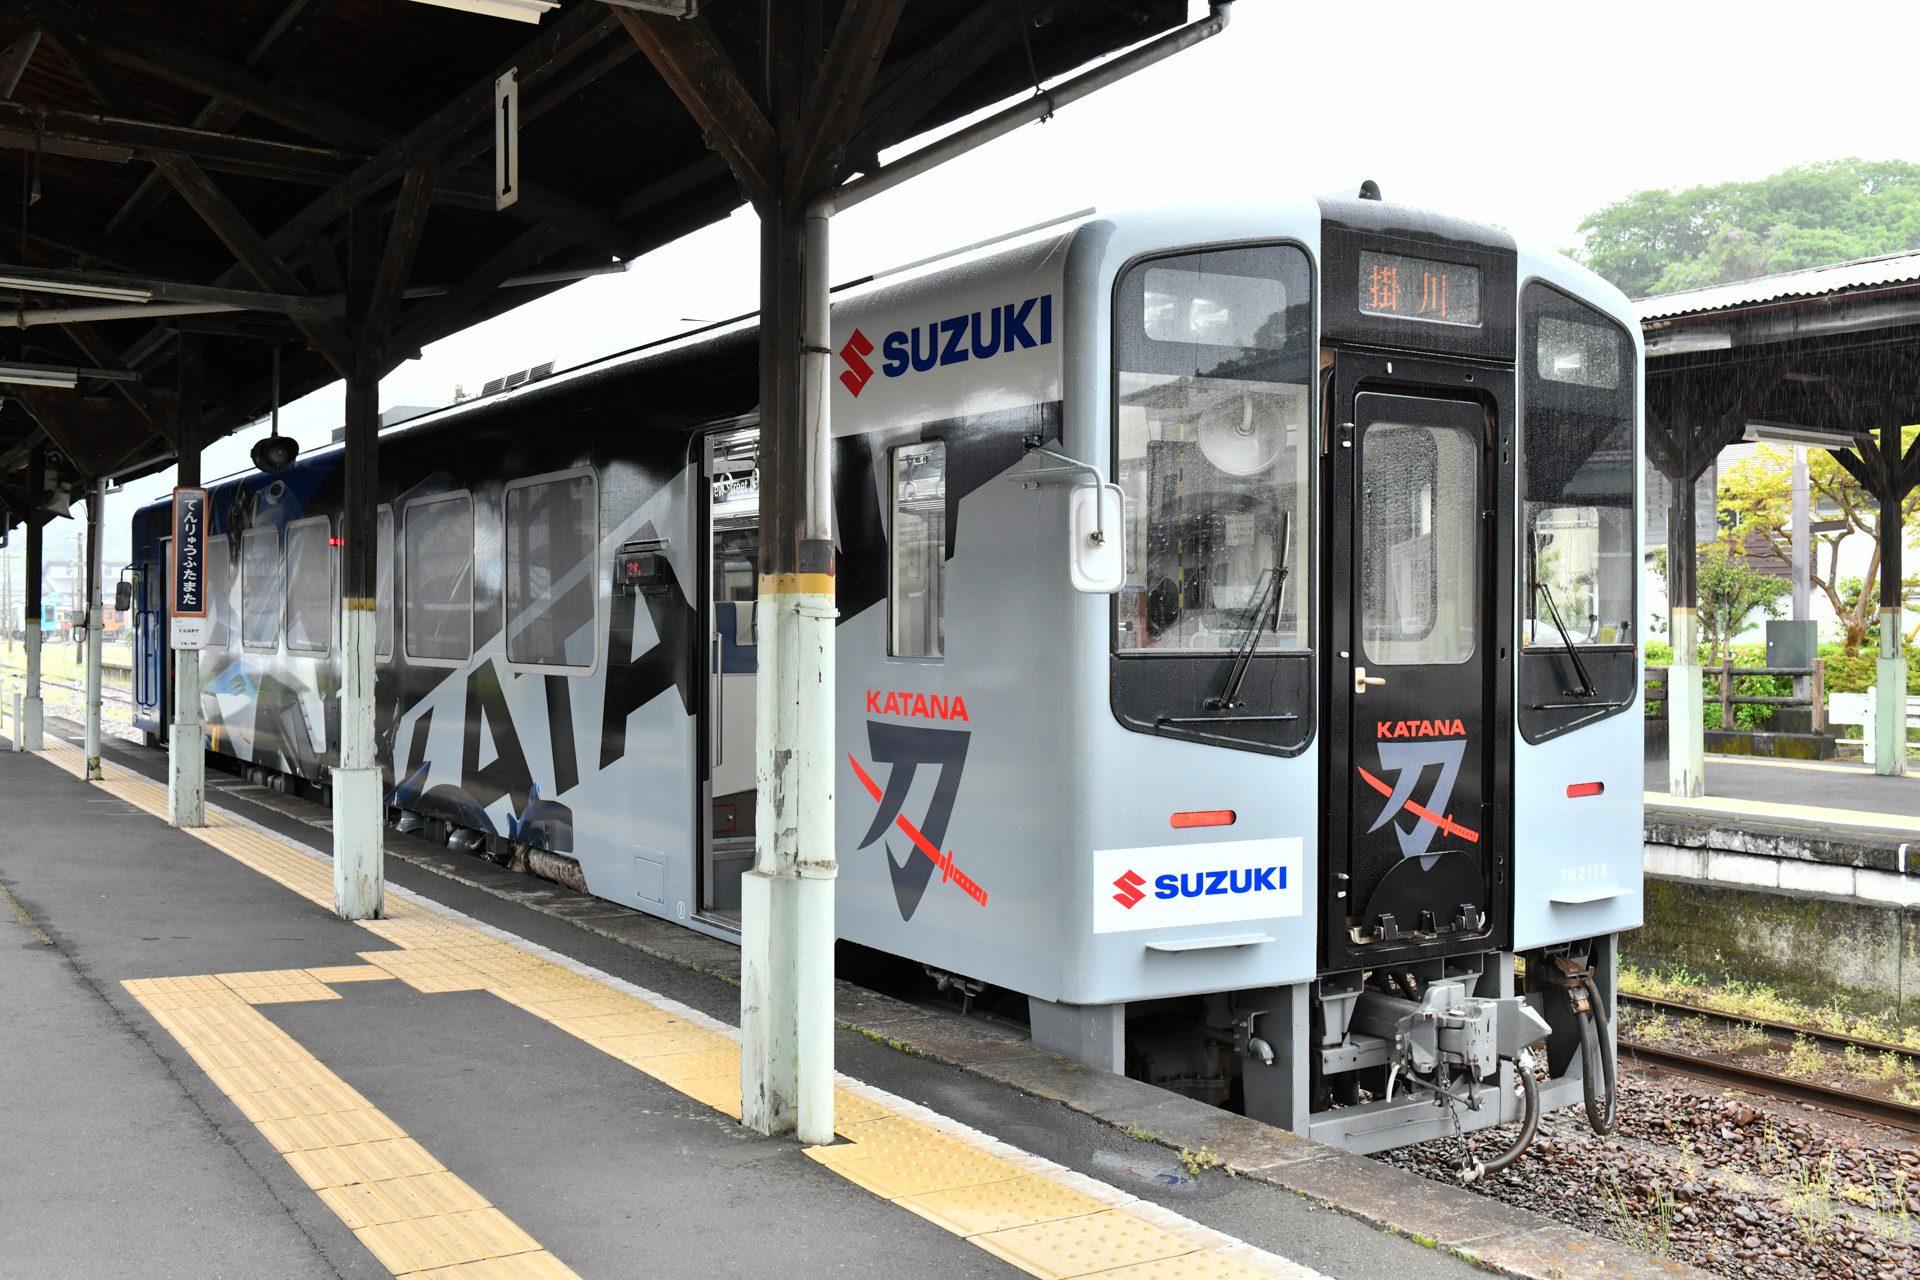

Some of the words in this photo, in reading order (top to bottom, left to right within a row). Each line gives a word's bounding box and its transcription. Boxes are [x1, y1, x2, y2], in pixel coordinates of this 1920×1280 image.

[502, 95, 511, 196] 1
[1370, 265, 1447, 317] 掛川
[883, 294, 1052, 378] SUZUKI
[182, 499, 198, 605] てんりゅうふたまた
[866, 689, 970, 722] KATANA
[1376, 718, 1467, 739] KATANA
[1154, 865, 1288, 901] SUZUKI
